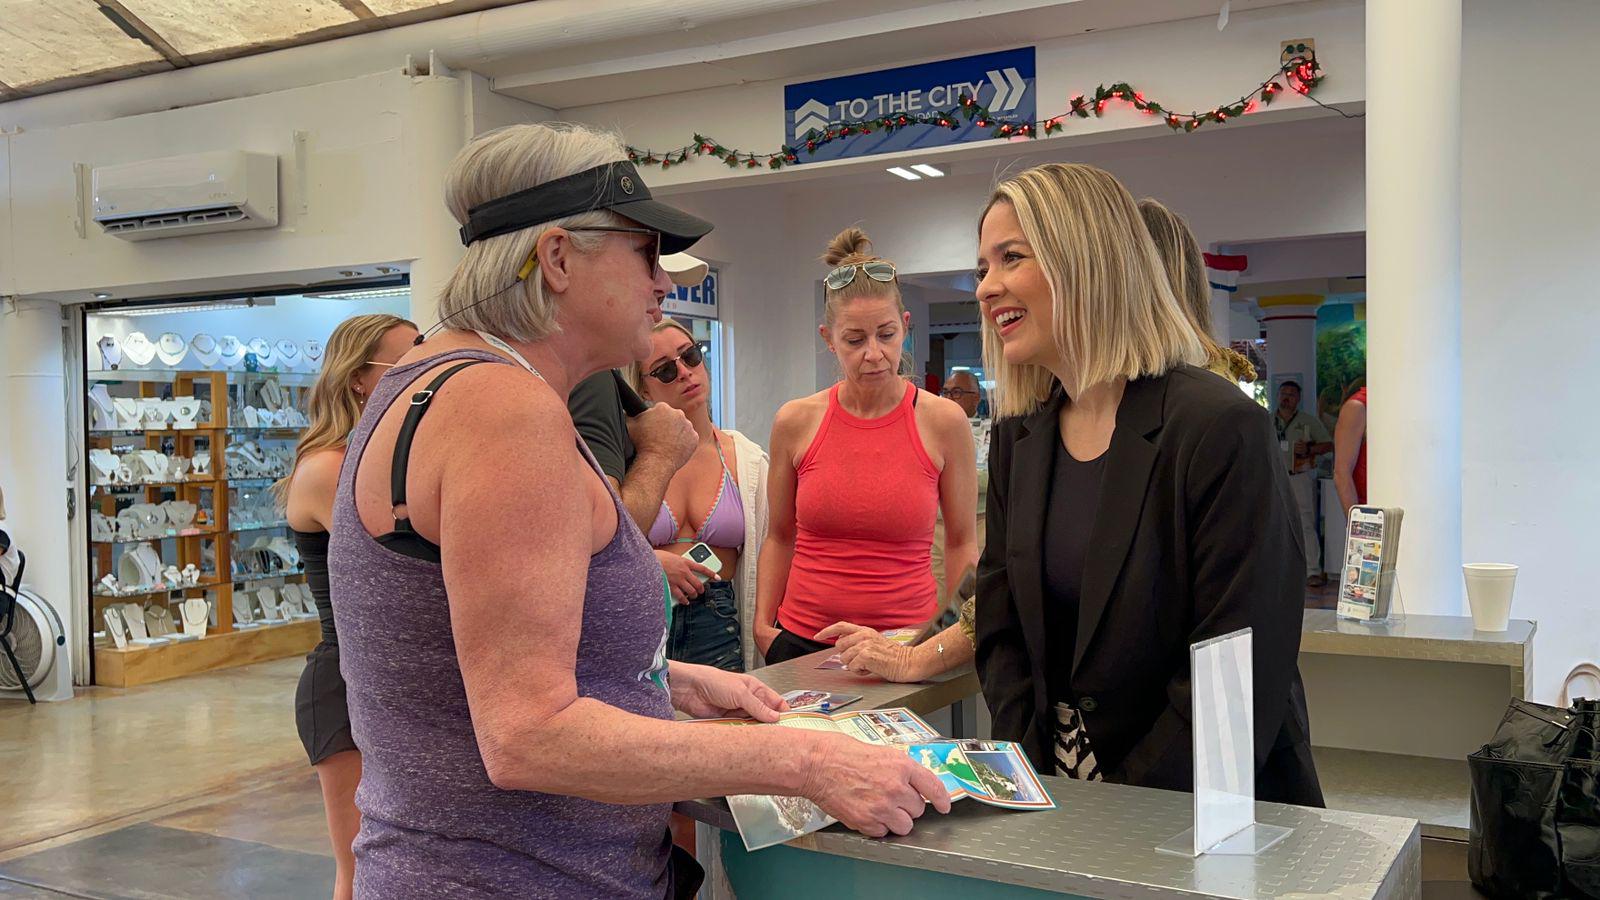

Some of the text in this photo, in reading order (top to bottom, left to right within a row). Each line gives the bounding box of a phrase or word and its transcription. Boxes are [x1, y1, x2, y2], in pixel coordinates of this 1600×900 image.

[835, 79, 984, 120] TO THE CITY
